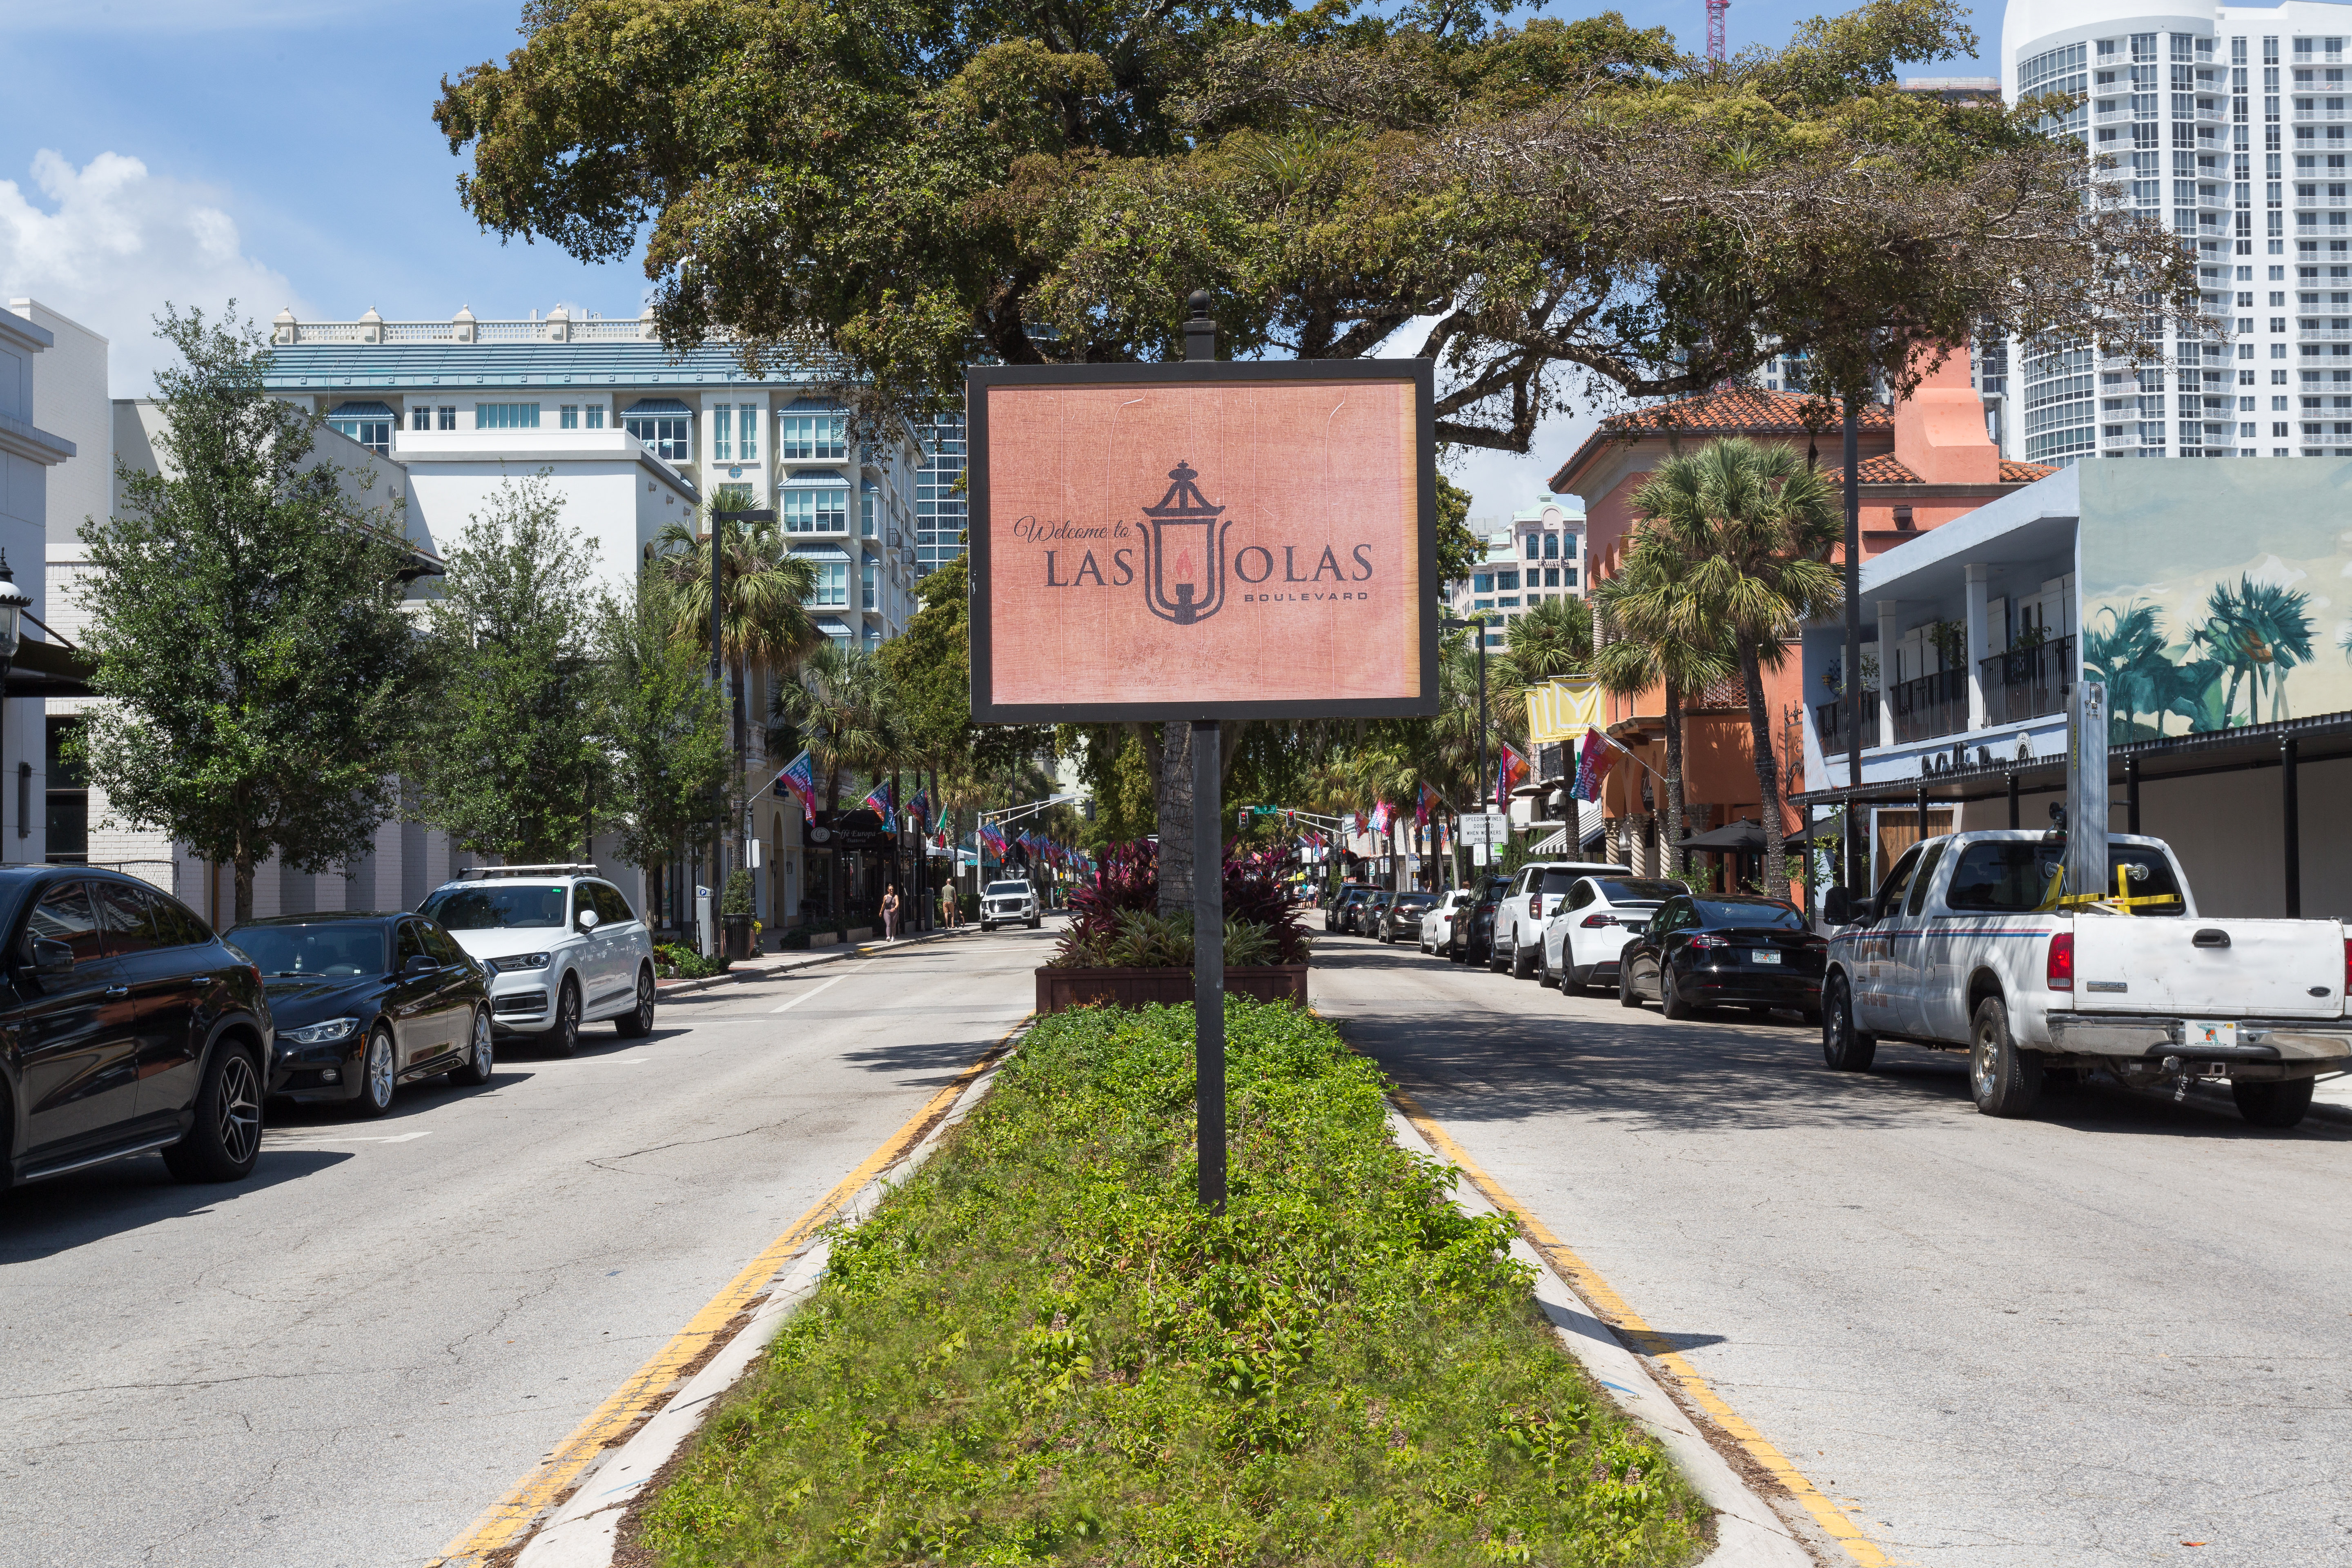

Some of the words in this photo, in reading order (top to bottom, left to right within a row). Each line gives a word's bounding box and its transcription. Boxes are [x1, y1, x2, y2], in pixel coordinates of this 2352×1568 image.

[1014, 516, 1108, 543] Welcome
[1114, 520, 1131, 538] to
[1043, 549, 1134, 586] LAS
[1234, 544, 1373, 583] OLAS
[1245, 592, 1368, 602] BOULEVARD
[1564, 692, 1591, 719] Y
[1509, 757, 1520, 771] MONTH
[788, 769, 807, 793] LIMITS
[1576, 756, 1595, 798] WITHOUT
[1583, 773, 1597, 800] LIMITS
[851, 830, 876, 838] Europa
[982, 828, 991, 841] LIMITS
[987, 825, 998, 844] WITHOUT
